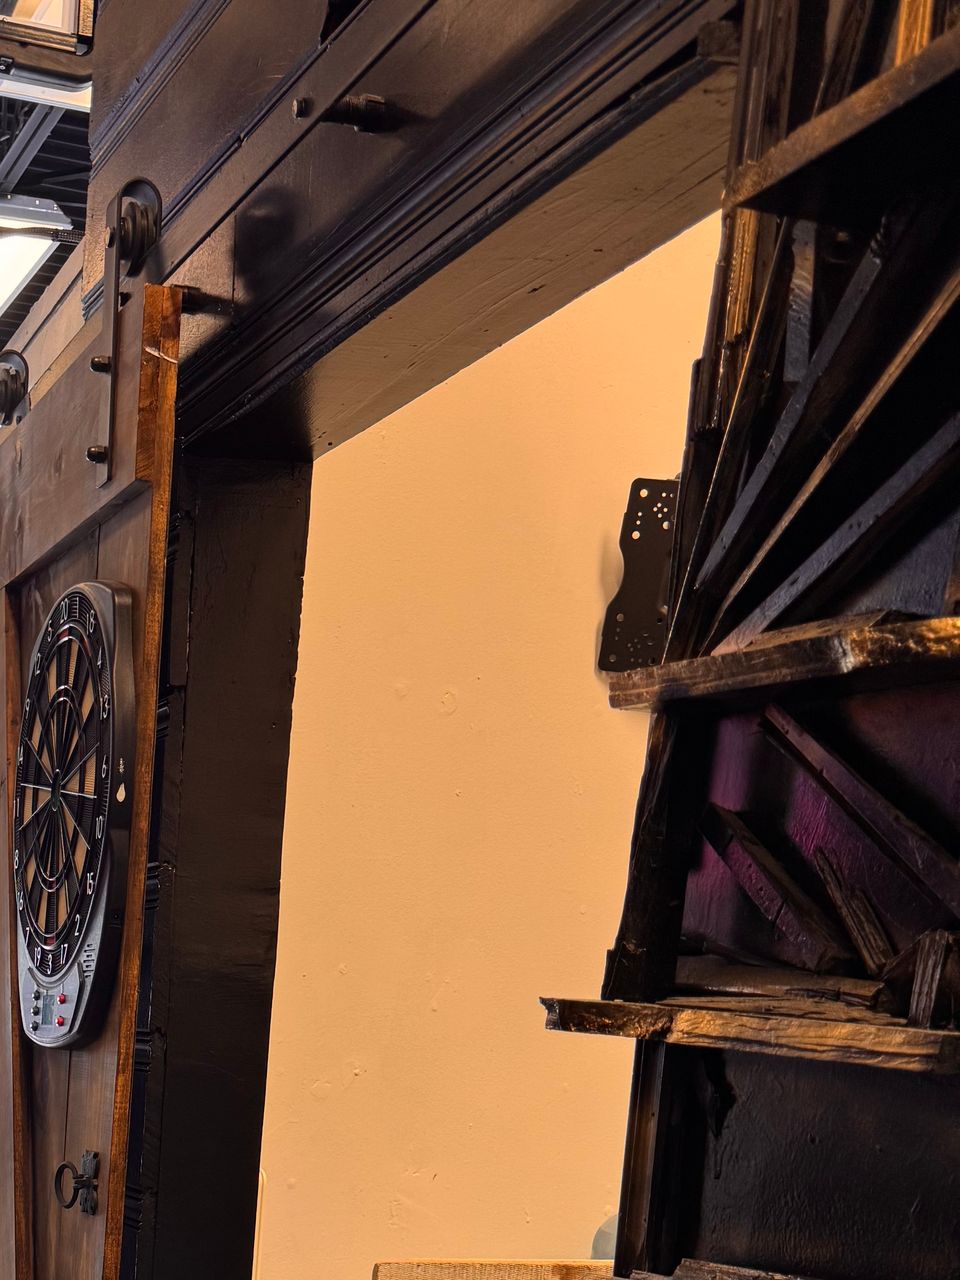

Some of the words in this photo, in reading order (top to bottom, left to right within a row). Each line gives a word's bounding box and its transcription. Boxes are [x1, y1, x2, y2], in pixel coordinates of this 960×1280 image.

[60, 598, 69, 624] 20
[86, 609, 96, 635] 18
[47, 619, 53, 642] 5
[34, 652, 42, 677] 12
[97, 646, 102, 670] 4
[25, 698, 31, 719] 9
[100, 694, 109, 720] 13
[101, 754, 107, 778] 6
[95, 815, 104, 839] 10
[14, 849, 19, 869] 8
[86, 872, 94, 895] 15
[17, 891, 24, 911] 16
[25, 926, 30, 946] 7
[74, 914, 81, 936] 2
[34, 947, 42, 968] 19
[47, 953, 53, 975] 3
[60, 943, 69, 965] 17
